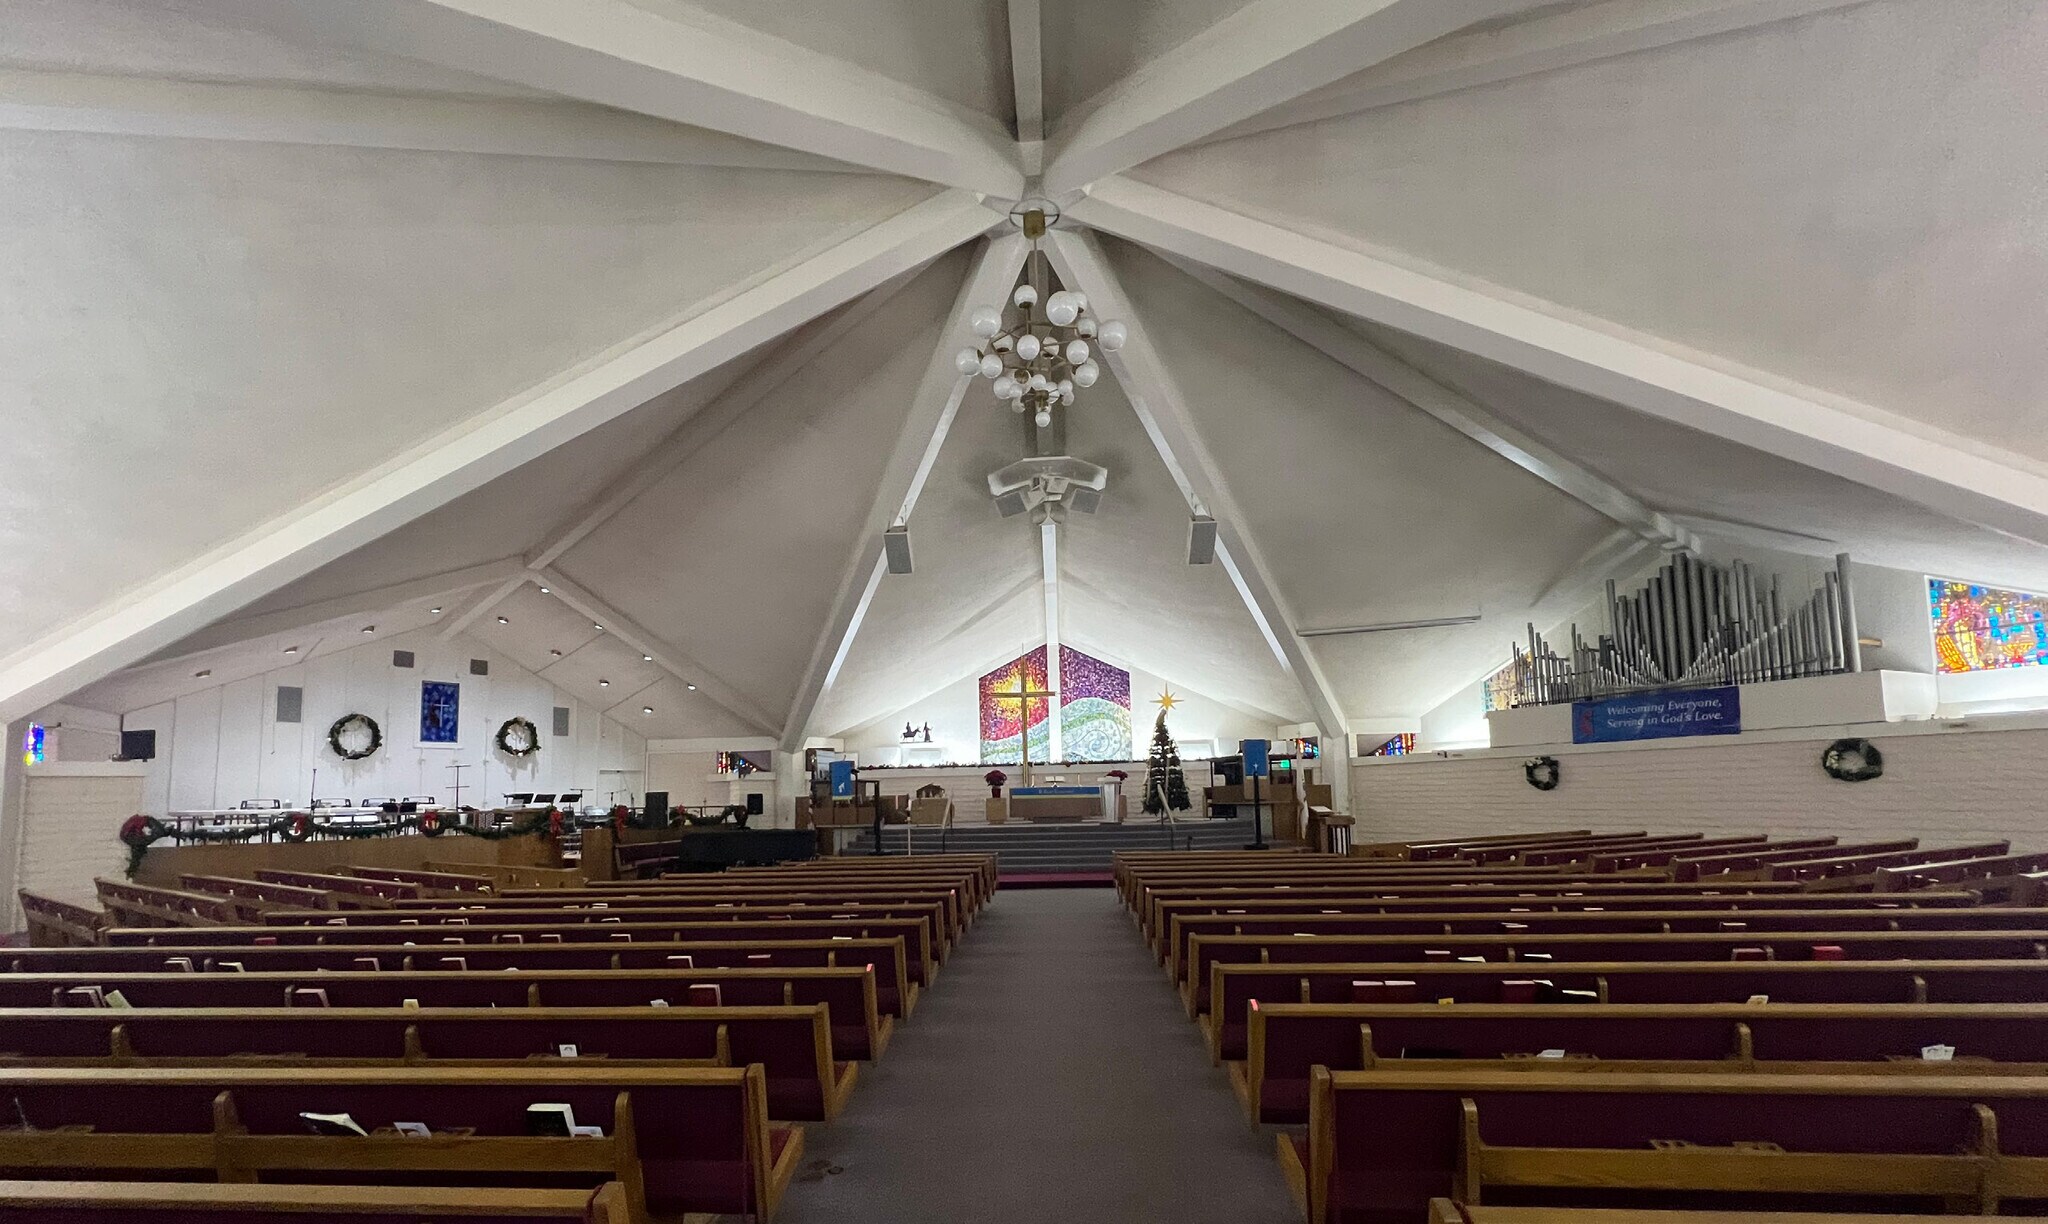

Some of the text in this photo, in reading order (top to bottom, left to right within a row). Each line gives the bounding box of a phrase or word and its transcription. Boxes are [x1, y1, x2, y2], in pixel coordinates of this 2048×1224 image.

[1607, 699, 1722, 715] Welcoming Everyone,
[1607, 710, 1723, 729] Serving in God's Love.
